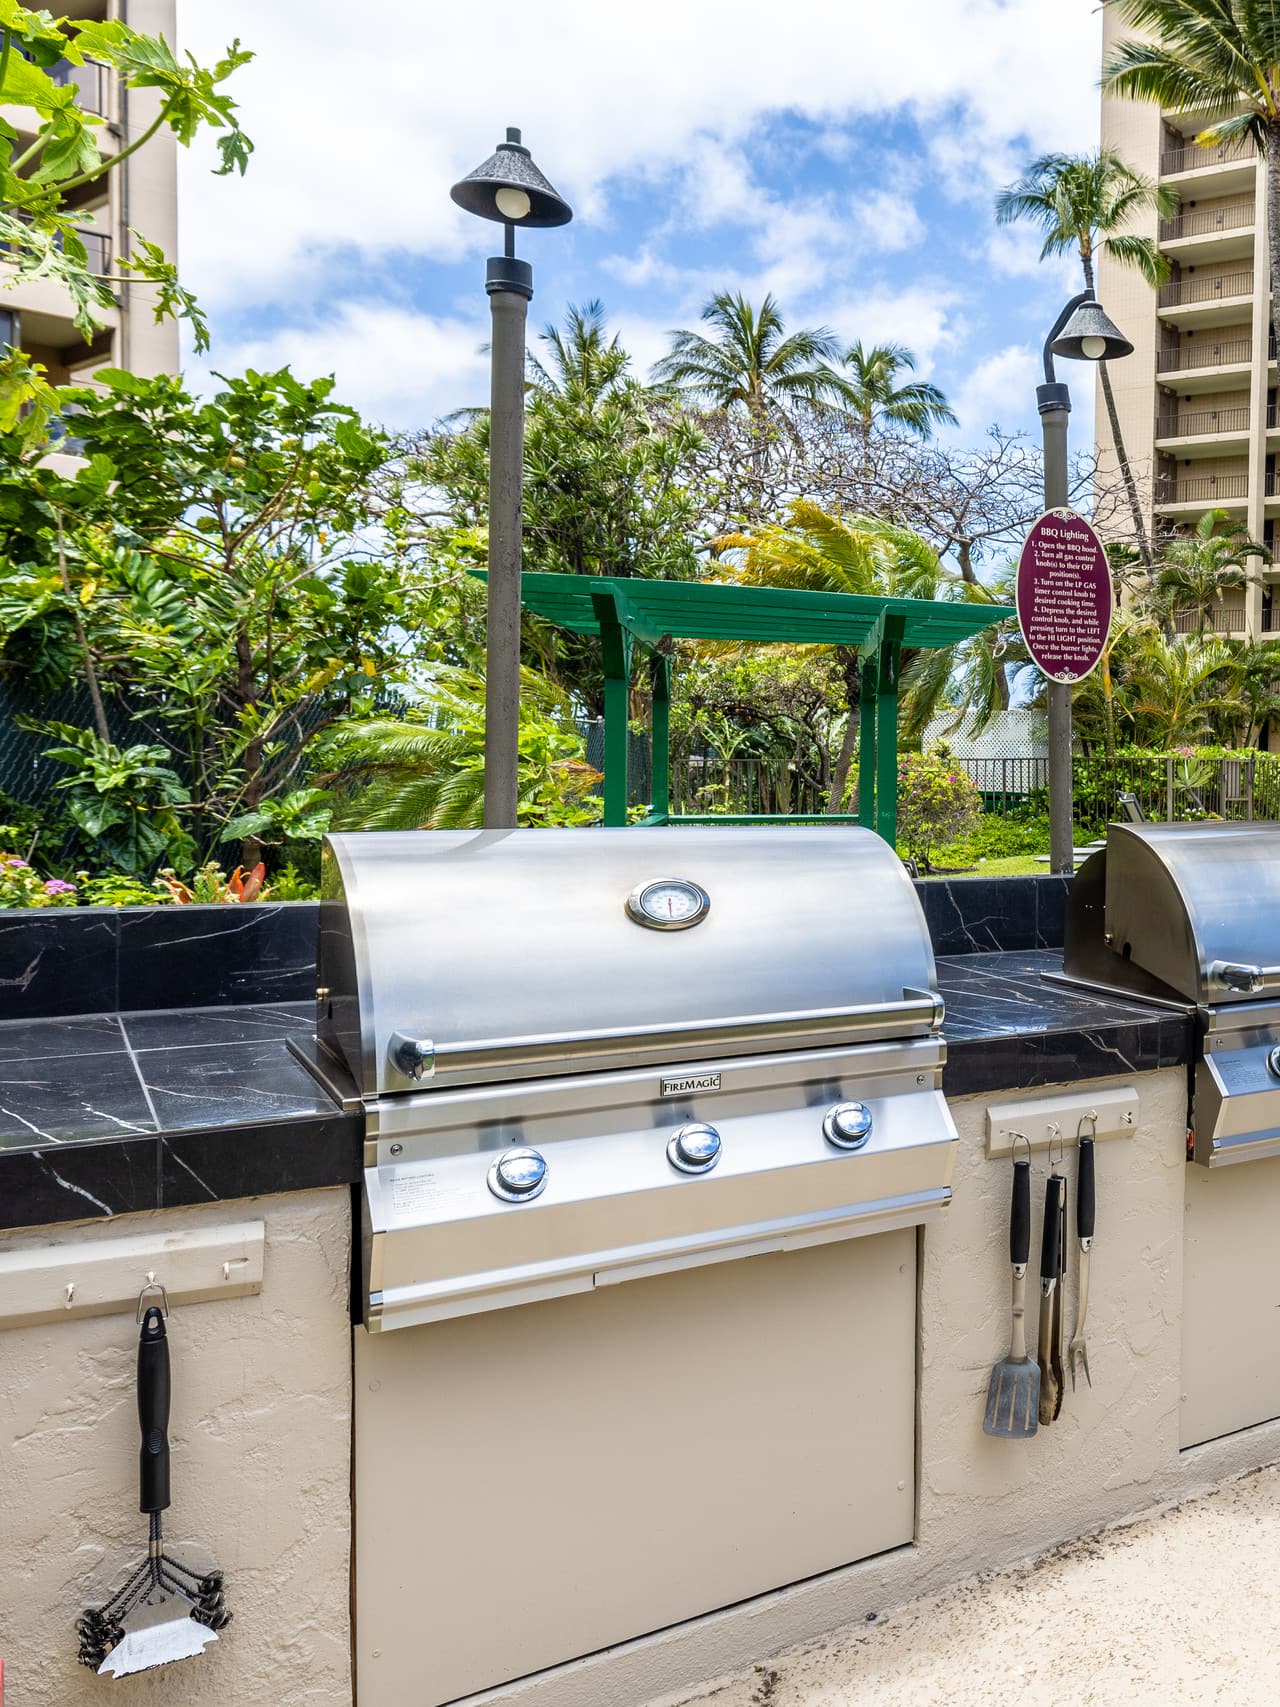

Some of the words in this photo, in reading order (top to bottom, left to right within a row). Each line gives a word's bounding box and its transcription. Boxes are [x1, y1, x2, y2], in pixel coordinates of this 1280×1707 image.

[1041, 528, 1058, 538] BBQ
[1060, 529, 1088, 542] Lighting
[1038, 542, 1055, 550] Open
[1067, 544, 1080, 552] BBQ
[1036, 558, 1057, 568] knob(s)
[1034, 596, 1056, 604] desired
[1057, 599, 1080, 607] cooking
[1041, 606, 1064, 615] Depress
[1054, 616, 1070, 624] knob,
[1030, 625, 1054, 634] pressing
[1061, 644, 1080, 652] burner
